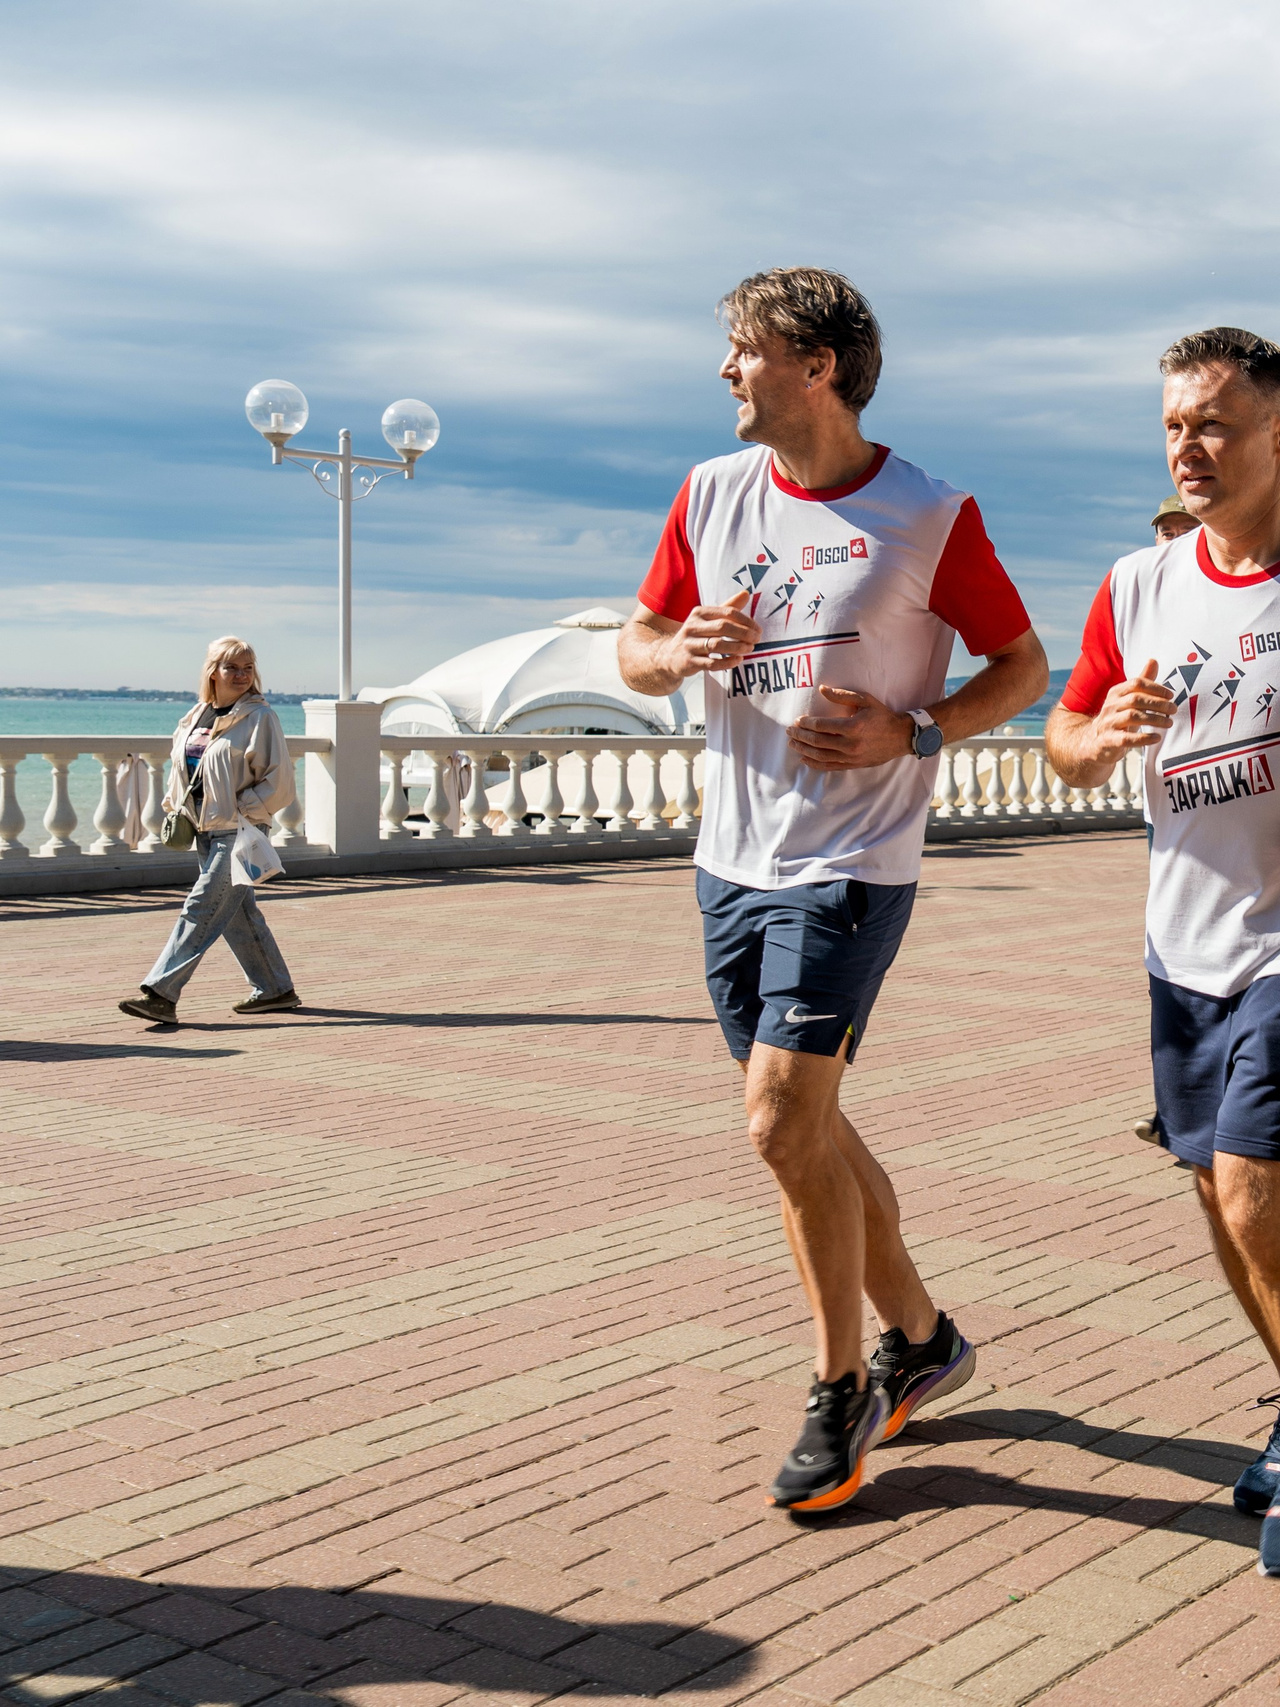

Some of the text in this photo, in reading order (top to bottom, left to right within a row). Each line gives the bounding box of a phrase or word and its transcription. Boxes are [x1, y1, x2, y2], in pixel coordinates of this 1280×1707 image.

[802, 545, 849, 571] BOSCO
[726, 653, 814, 699] АРЯДКА
[1163, 753, 1276, 814] ЗАРЯДКА
